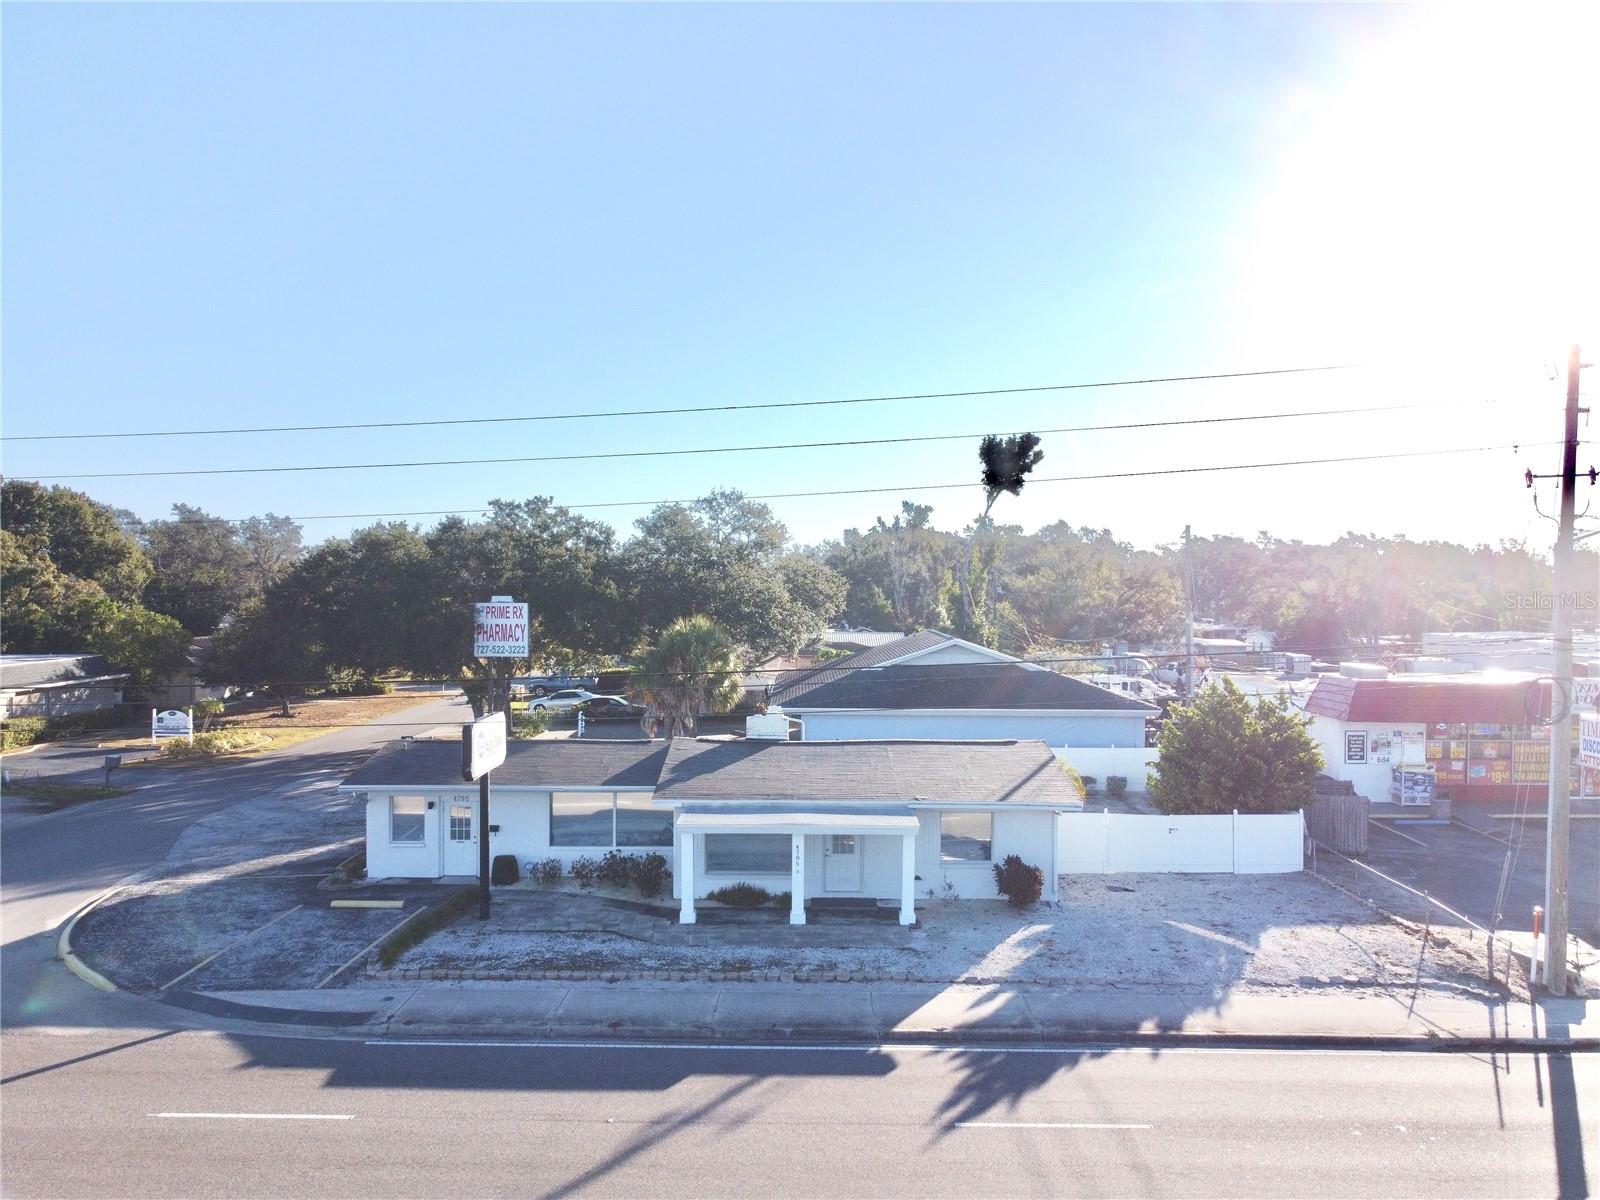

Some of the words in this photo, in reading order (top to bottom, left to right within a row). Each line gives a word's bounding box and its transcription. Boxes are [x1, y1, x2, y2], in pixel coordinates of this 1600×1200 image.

[485, 606, 511, 619] PRIME
[512, 606, 524, 619] RX
[476, 624, 526, 642] PHARMACY
[476, 645, 526, 654] 727-522-3222
